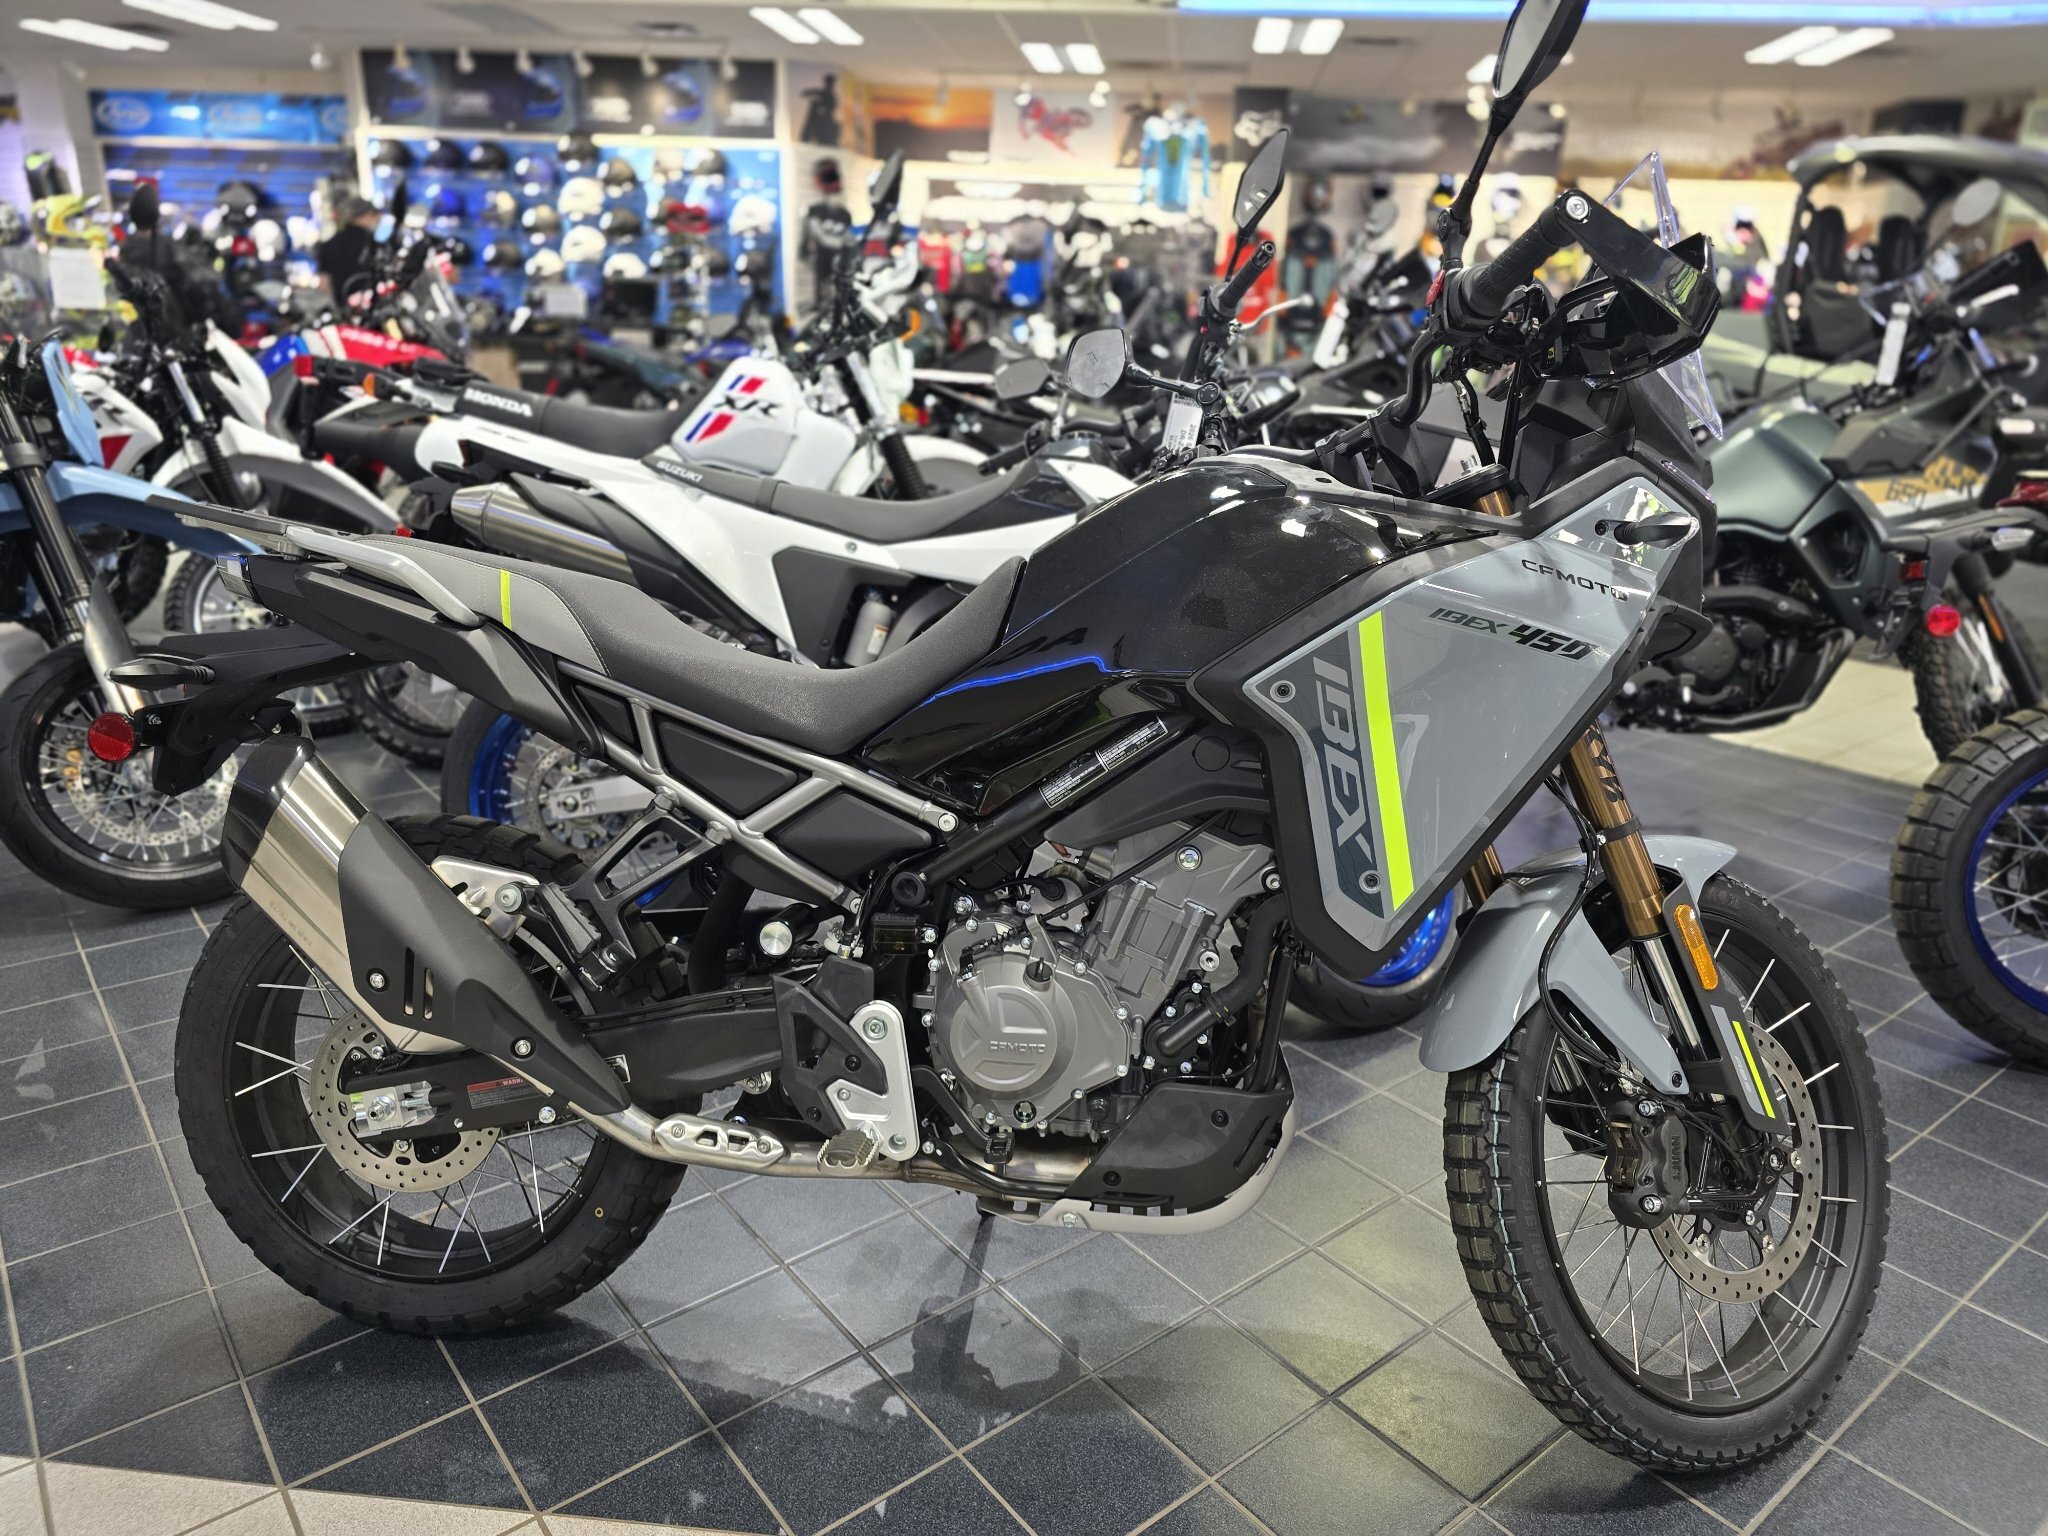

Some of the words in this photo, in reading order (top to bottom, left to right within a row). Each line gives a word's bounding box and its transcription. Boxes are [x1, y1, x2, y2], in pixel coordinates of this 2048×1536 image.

[464, 388, 533, 418] HONDA
[656, 460, 703, 483] SUZUKI
[1521, 558, 1628, 601] CFMOTO
[1428, 607, 1509, 634] IBEX
[1508, 624, 1596, 661] 450
[1312, 656, 1373, 864] IBEX
[989, 1040, 1047, 1054] CFMOTO
